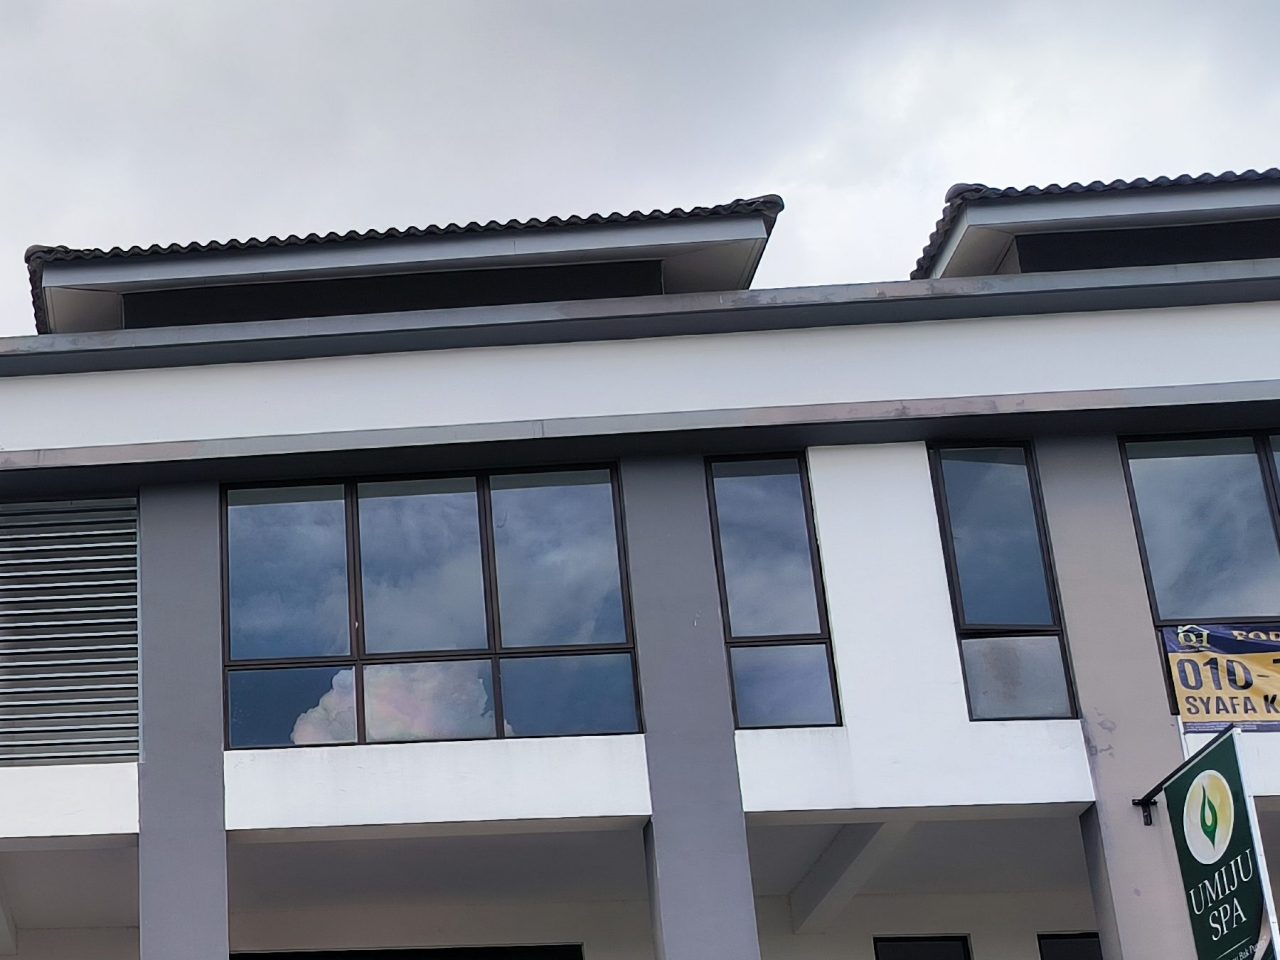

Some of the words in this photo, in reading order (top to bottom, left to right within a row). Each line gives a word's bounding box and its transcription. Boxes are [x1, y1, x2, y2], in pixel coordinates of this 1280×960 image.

[1185, 695, 1258, 715] SYAFA
[1189, 848, 1254, 915] UMIJU
[1209, 897, 1247, 941] SPA
